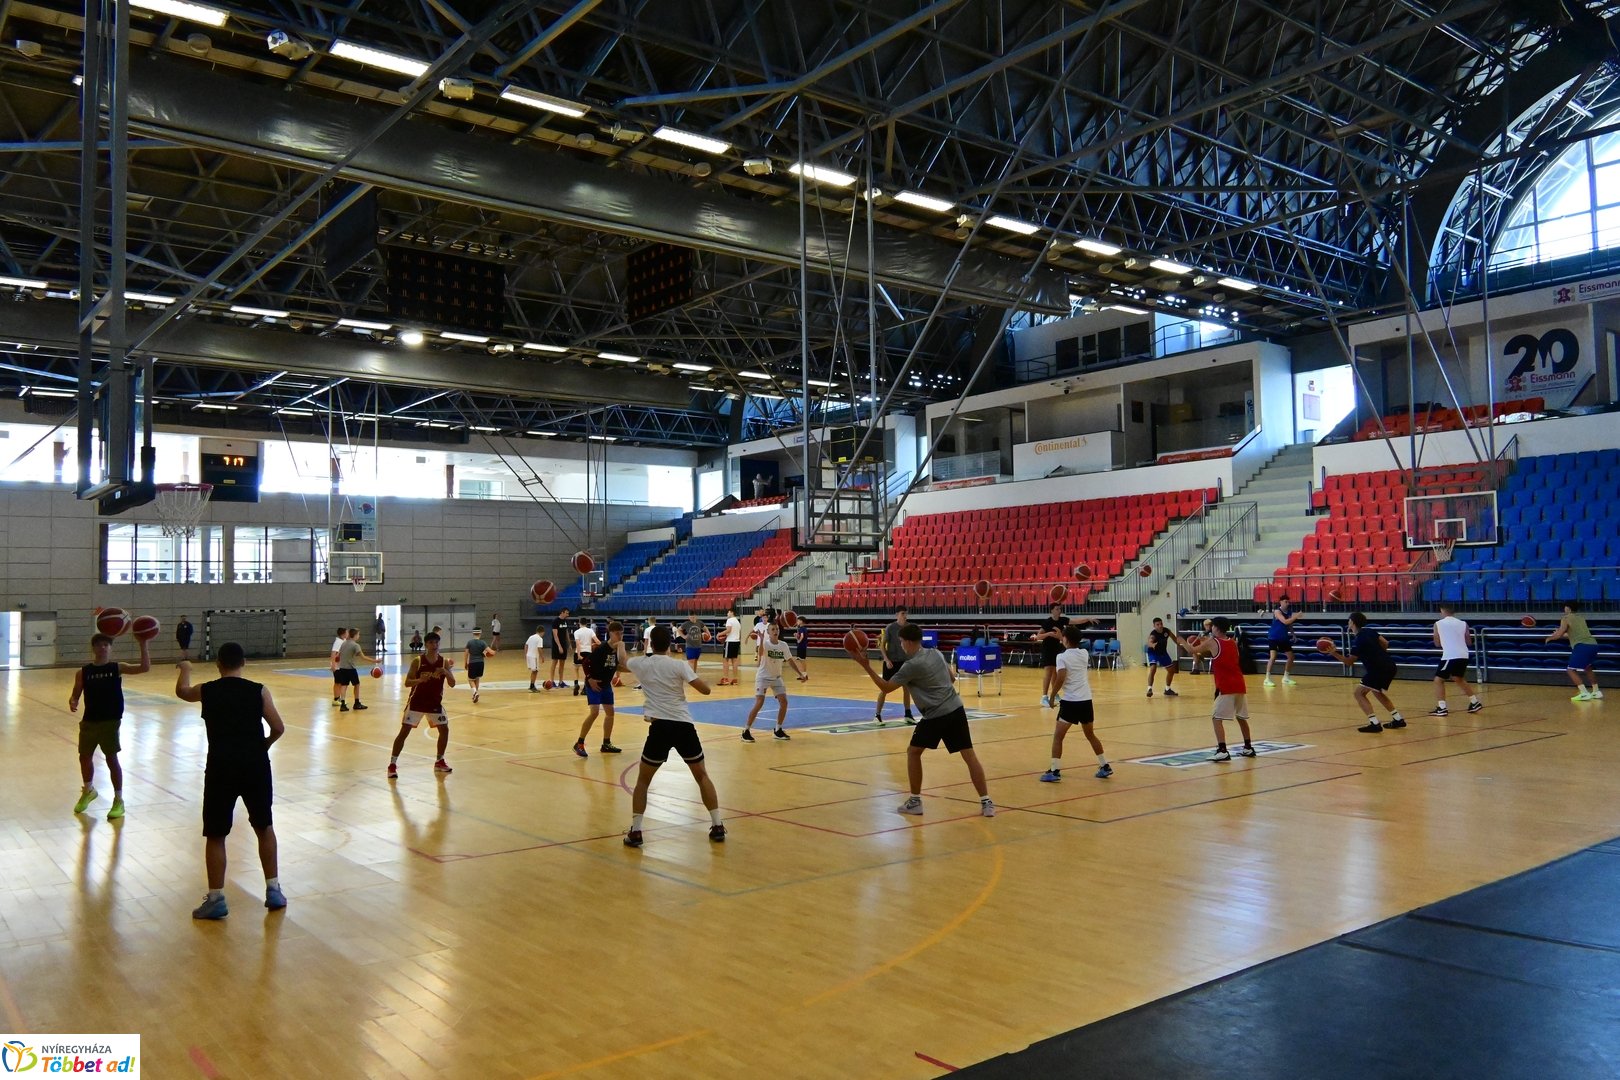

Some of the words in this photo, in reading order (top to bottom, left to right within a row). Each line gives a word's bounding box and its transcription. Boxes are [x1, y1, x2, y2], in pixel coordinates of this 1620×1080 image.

[1504, 328, 1579, 379] 20
[1530, 371, 1576, 384] Eissmann
[1034, 438, 1080, 455] Continental
